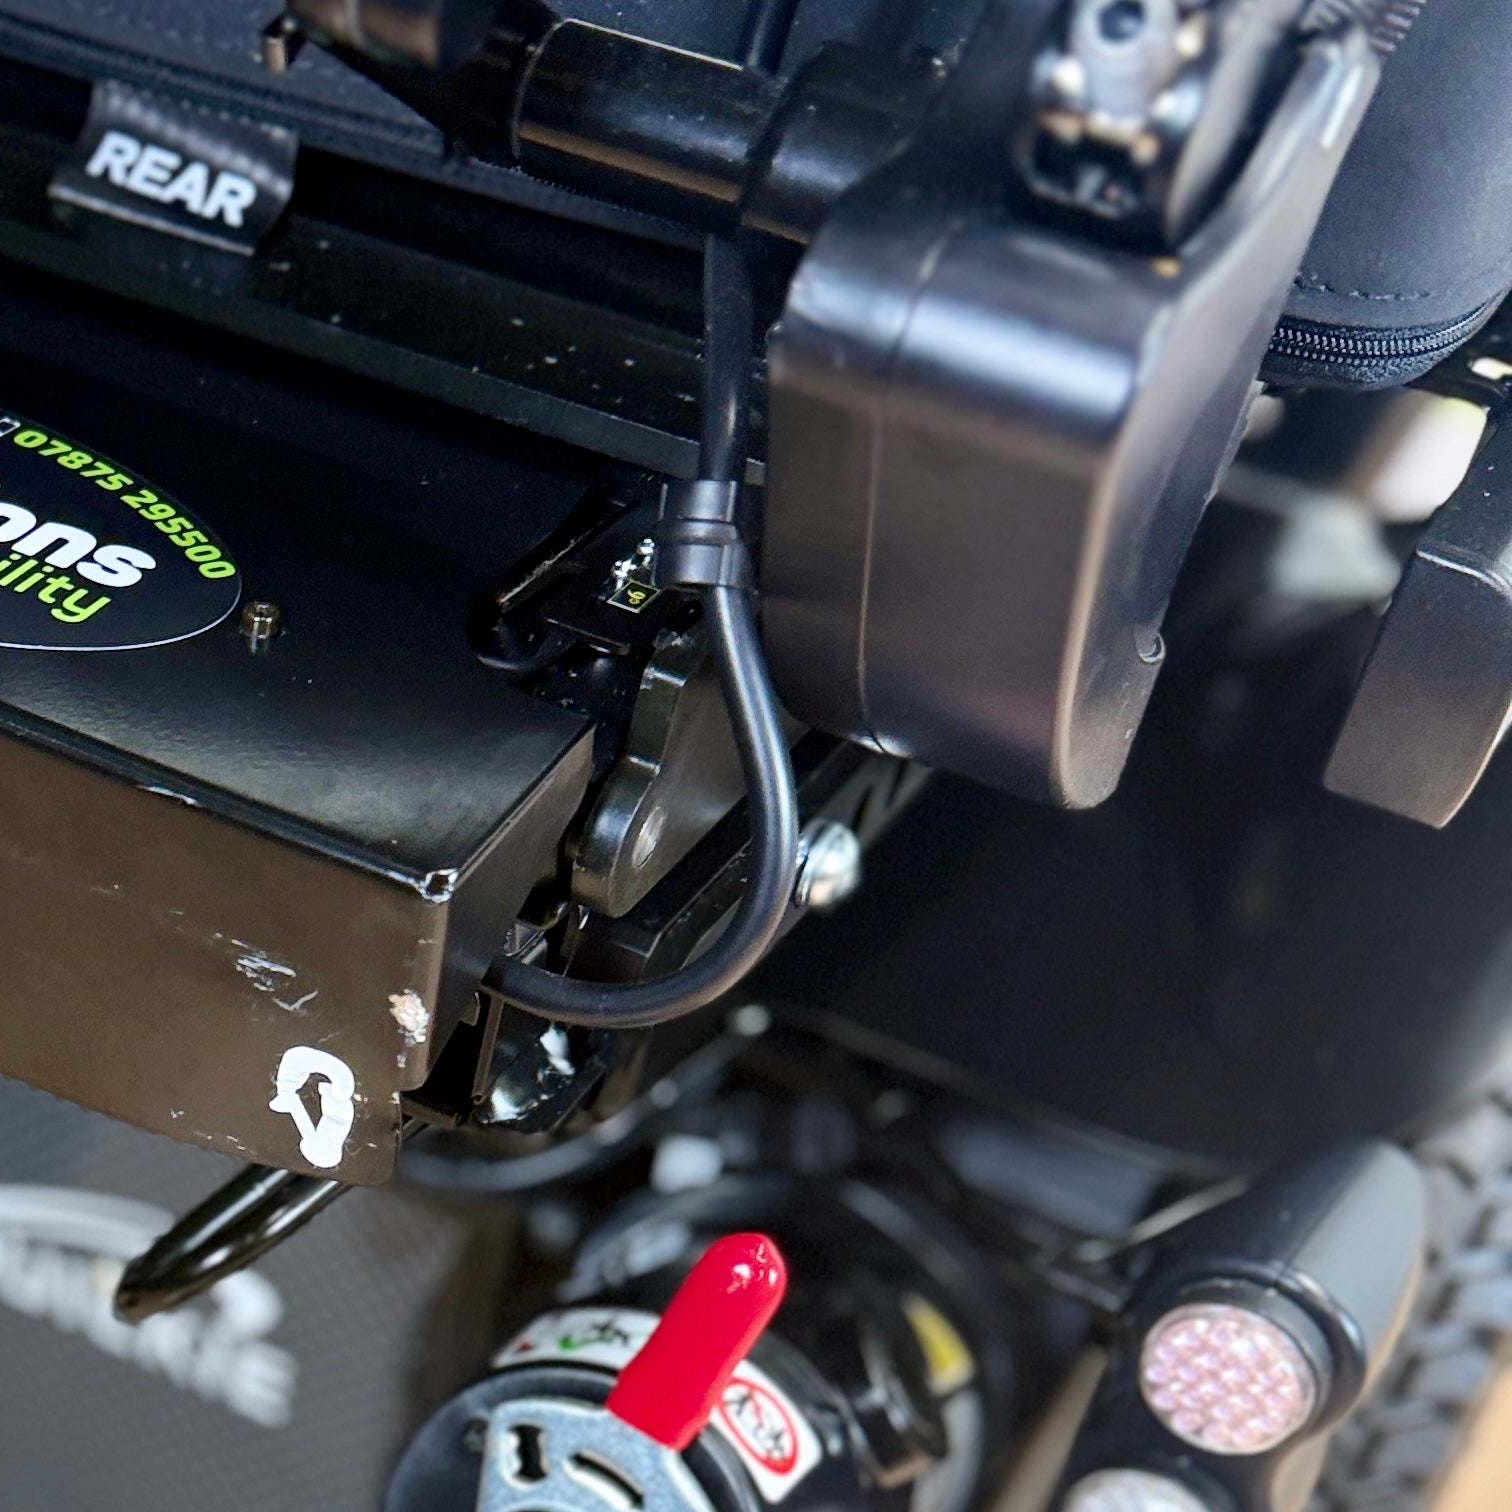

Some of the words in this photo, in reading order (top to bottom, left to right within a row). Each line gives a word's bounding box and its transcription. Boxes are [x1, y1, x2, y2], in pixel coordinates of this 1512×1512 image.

[86, 131, 256, 227] REAR
[13, 429, 135, 491] 07875
[119, 489, 236, 579] 295500
